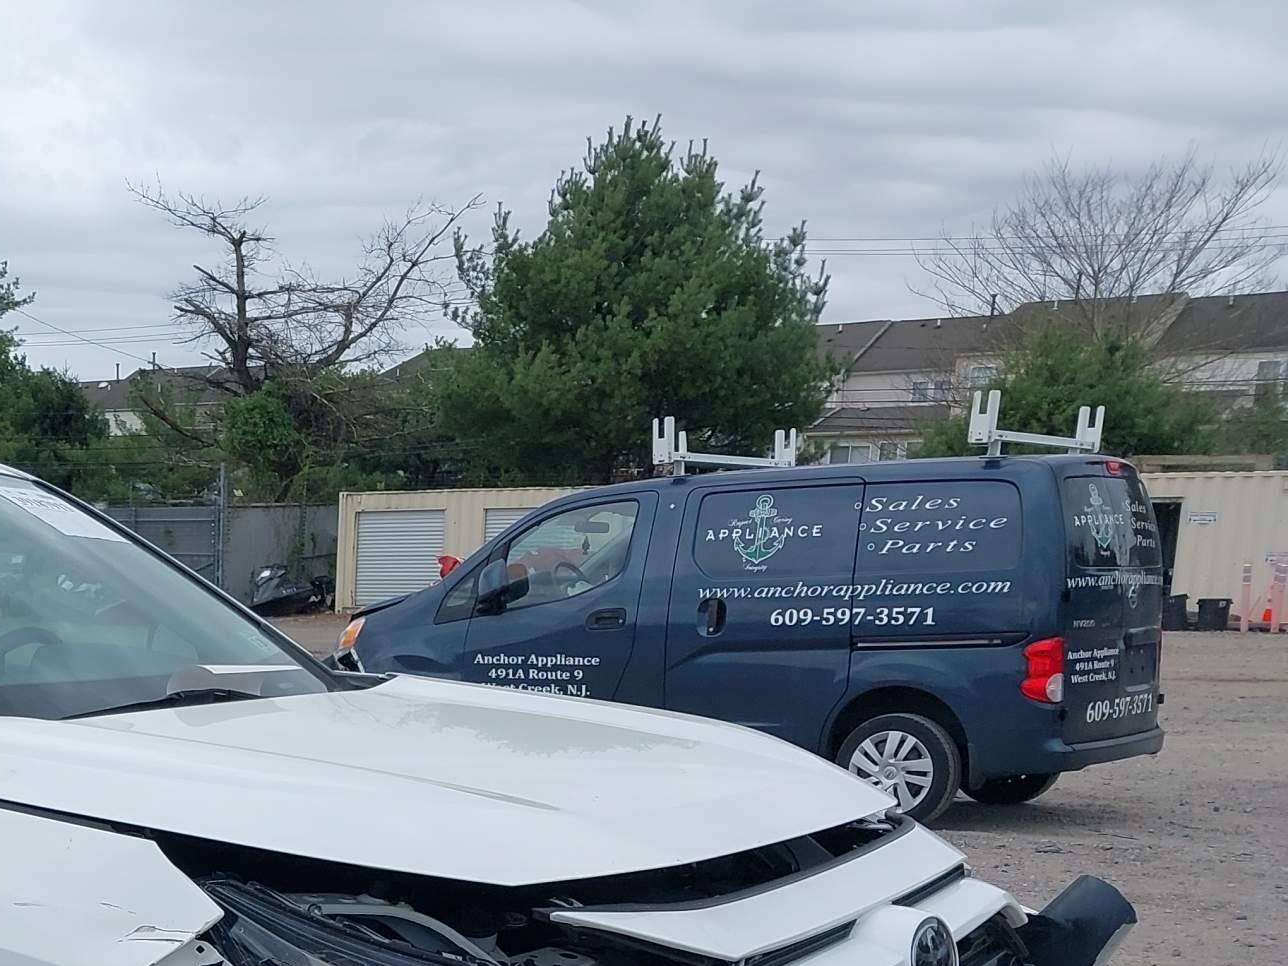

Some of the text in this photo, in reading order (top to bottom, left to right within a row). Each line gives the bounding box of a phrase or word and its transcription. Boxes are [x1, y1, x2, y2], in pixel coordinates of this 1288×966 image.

[865, 496, 961, 512] Sales
[705, 524, 823, 541] APPLIANCE
[870, 516, 1007, 533] Service
[878, 539, 977, 554] Parts
[697, 579, 1011, 601] www.anchorappliance.com
[769, 607, 936, 626] 609-597-3571
[474, 653, 601, 667] Anchor Appliance
[488, 668, 584, 680] 491A Route 9
[567, 686, 591, 697] N.J.
[1086, 693, 1153, 723] 609-597-3571
